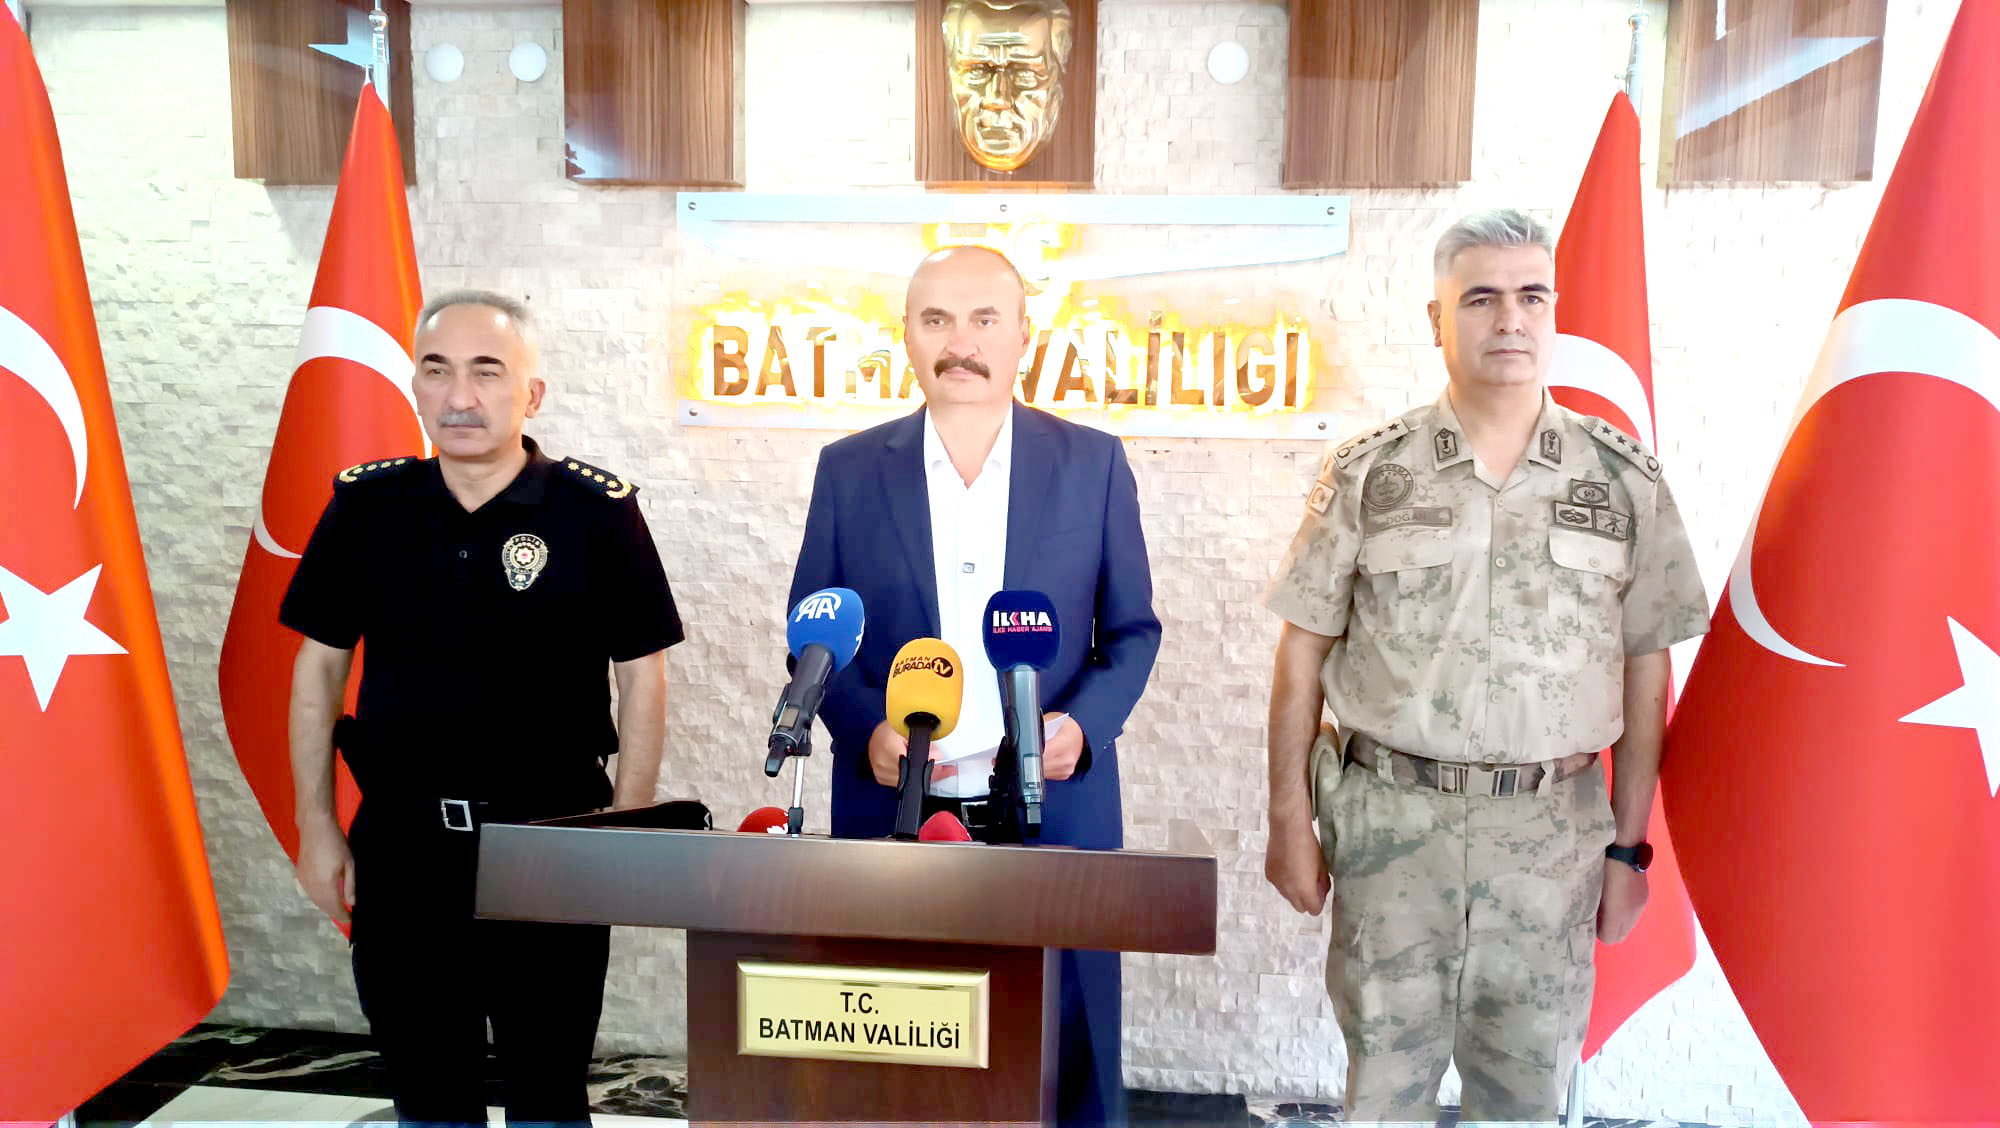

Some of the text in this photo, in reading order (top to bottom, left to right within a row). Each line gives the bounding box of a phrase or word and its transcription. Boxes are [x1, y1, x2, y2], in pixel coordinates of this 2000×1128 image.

[795, 593, 841, 622] AA
[840, 991, 879, 1014] T.C.
[759, 1017, 960, 1049] BATMAN VALİLİĞİ
